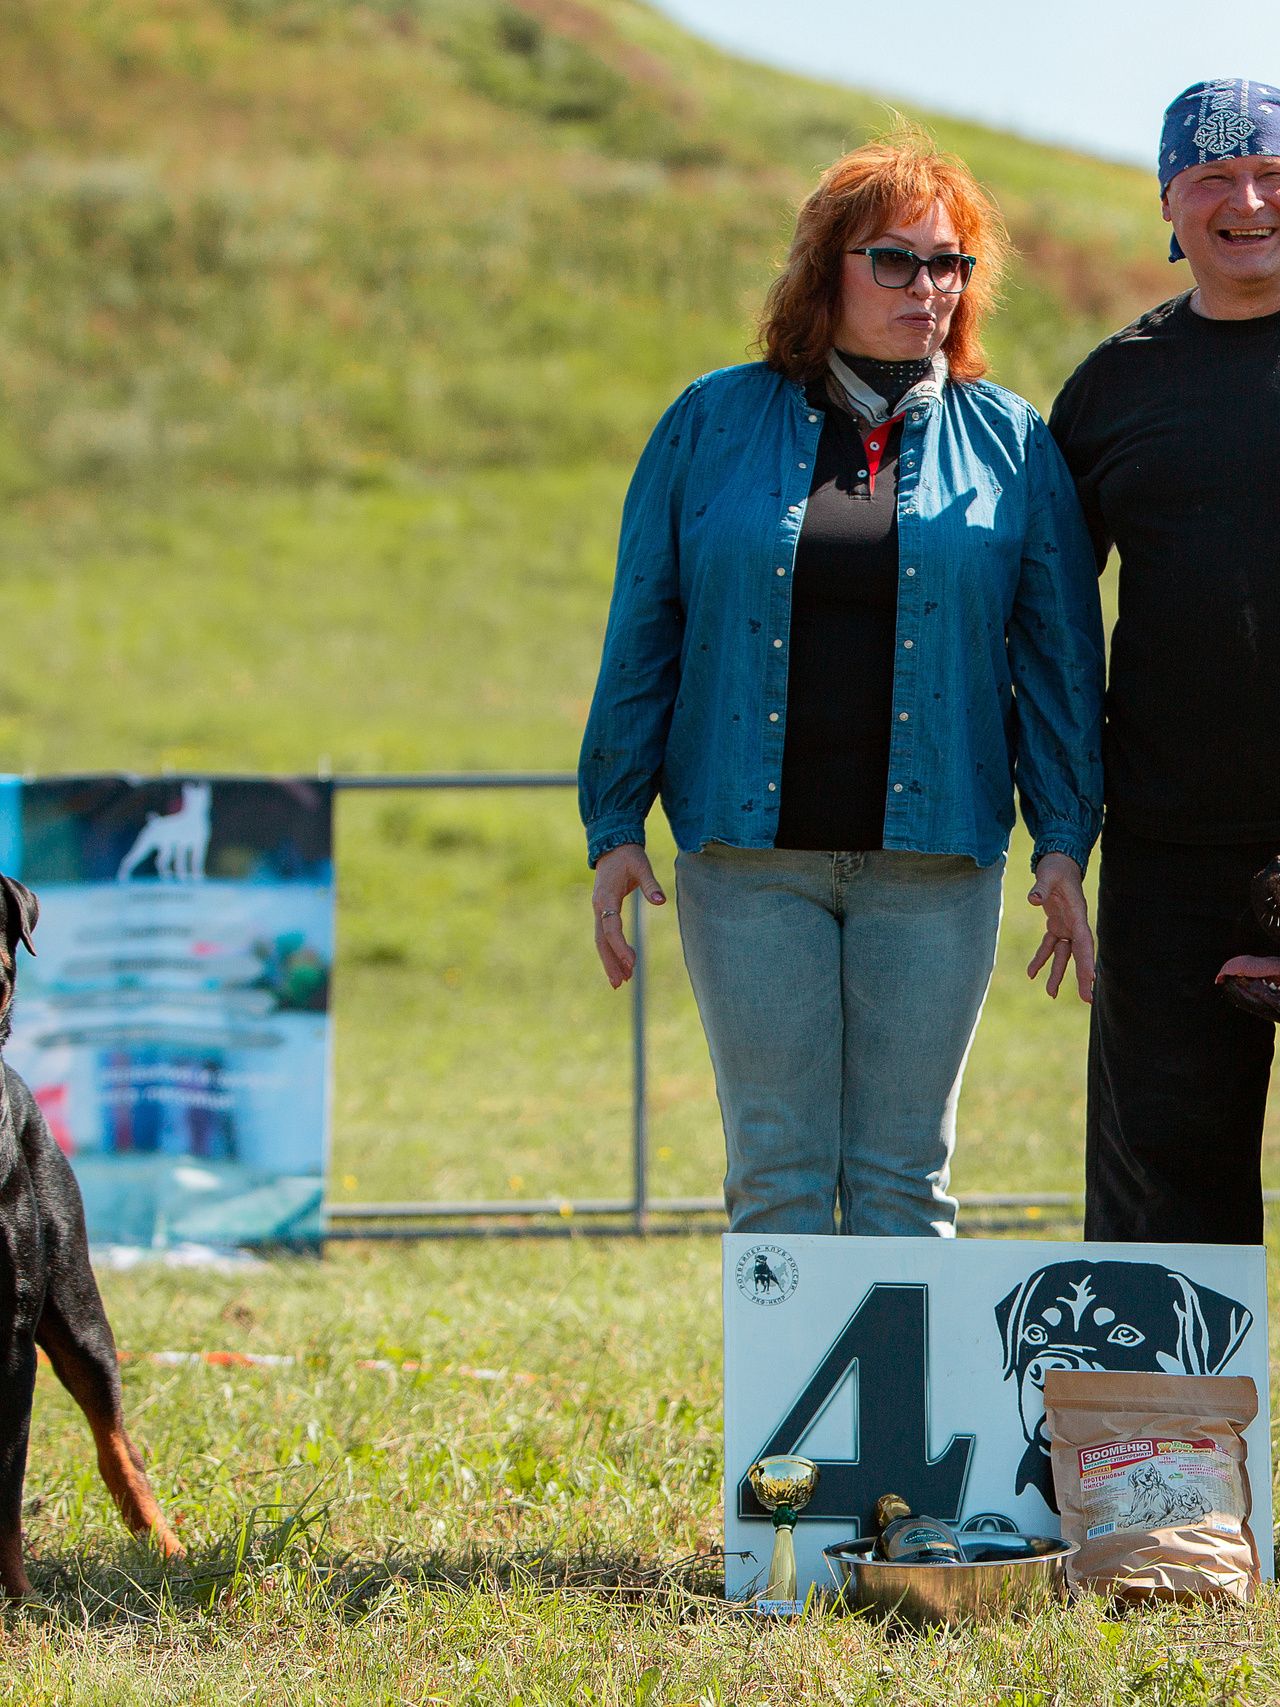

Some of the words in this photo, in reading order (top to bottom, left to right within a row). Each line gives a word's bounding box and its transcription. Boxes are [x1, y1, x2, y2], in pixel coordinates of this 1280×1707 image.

[787, 1256, 799, 1291] РОССИИ
[737, 1281, 976, 1540] 4
[1084, 1443, 1150, 1463] ЗООМЕНЮ
[1083, 1470, 1126, 1485] ПРОТЕИНОВЫЕ
[1083, 1481, 1105, 1490] ЧИПСЫ
